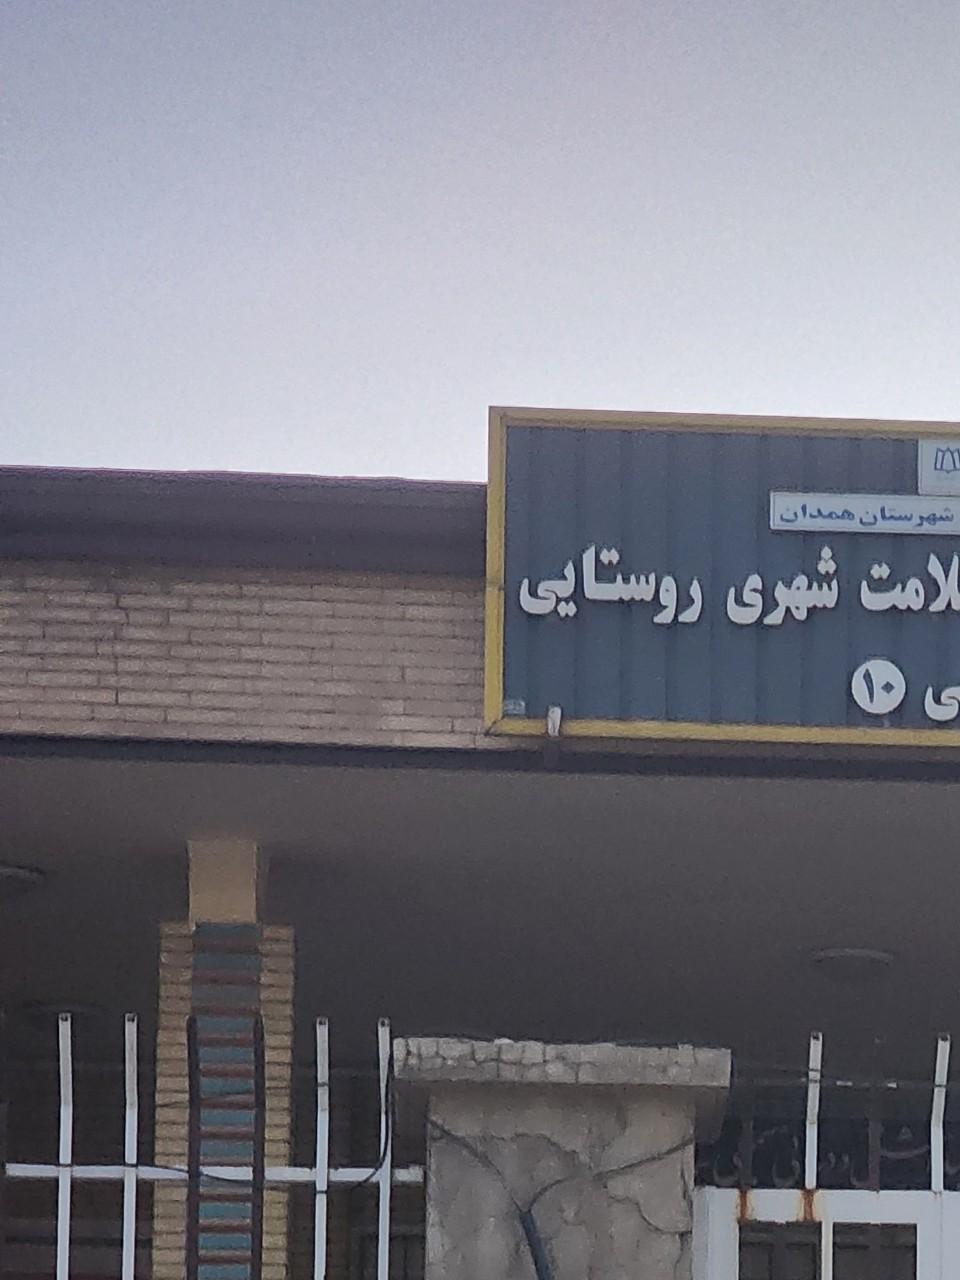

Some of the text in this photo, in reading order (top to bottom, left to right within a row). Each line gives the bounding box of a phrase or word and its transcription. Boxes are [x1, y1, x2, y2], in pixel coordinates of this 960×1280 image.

[780, 503, 856, 523] همدان
[859, 506, 954, 528] شهرستان
[519, 542, 703, 625] روستایی
[726, 545, 838, 626] شهری
[862, 667, 896, 704] ۱۰
